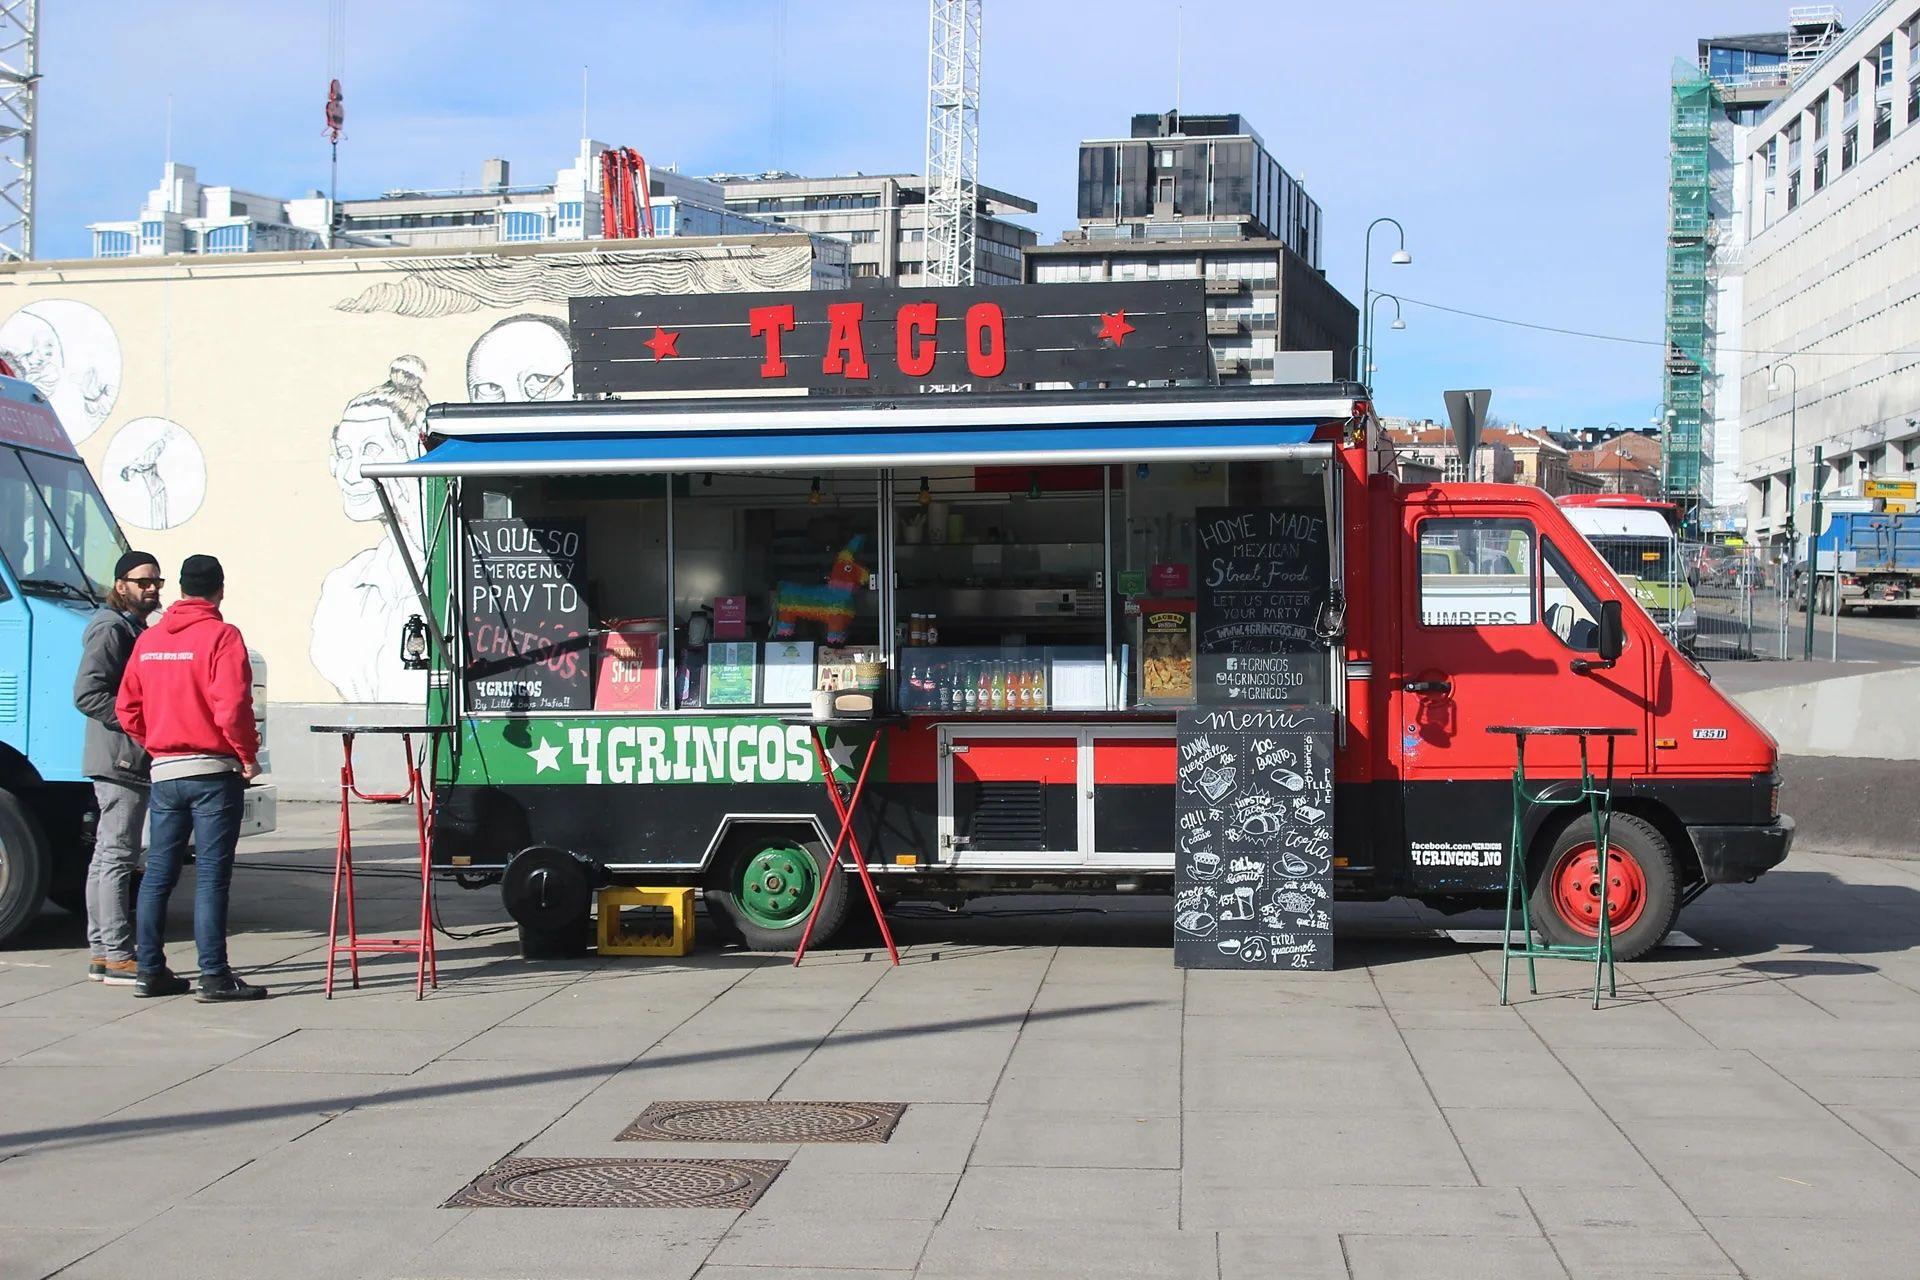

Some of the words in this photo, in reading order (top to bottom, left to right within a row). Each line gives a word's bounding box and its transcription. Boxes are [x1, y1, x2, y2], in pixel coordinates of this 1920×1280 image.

[749, 301, 1006, 380] TACO
[1199, 513, 1256, 549] HOME
[1269, 512, 1323, 543] MADE
[467, 530, 491, 557] IN
[497, 527, 579, 557] QUESO
[1233, 543, 1300, 558] MEXICAN
[474, 562, 575, 579] EMERGENCY
[473, 584, 535, 614] PRAY
[542, 583, 578, 613] TO
[1213, 595, 1236, 607] LET
[1244, 595, 1262, 606] US
[1270, 595, 1310, 606] CATER
[1223, 608, 1255, 618] YOUR
[1263, 608, 1300, 618] PARTY
[612, 661, 643, 683] SPICY
[475, 680, 543, 697] 4GRINGOS
[474, 698, 487, 710] By
[491, 697, 515, 709] Little
[568, 725, 814, 785] 4GRINGOS
[1256, 748, 1290, 770] BURRITO
[1411, 850, 1502, 867] 4GRINGOS.NO
[1270, 935, 1295, 946] EXTRA
[1271, 939, 1318, 964] guacamole
